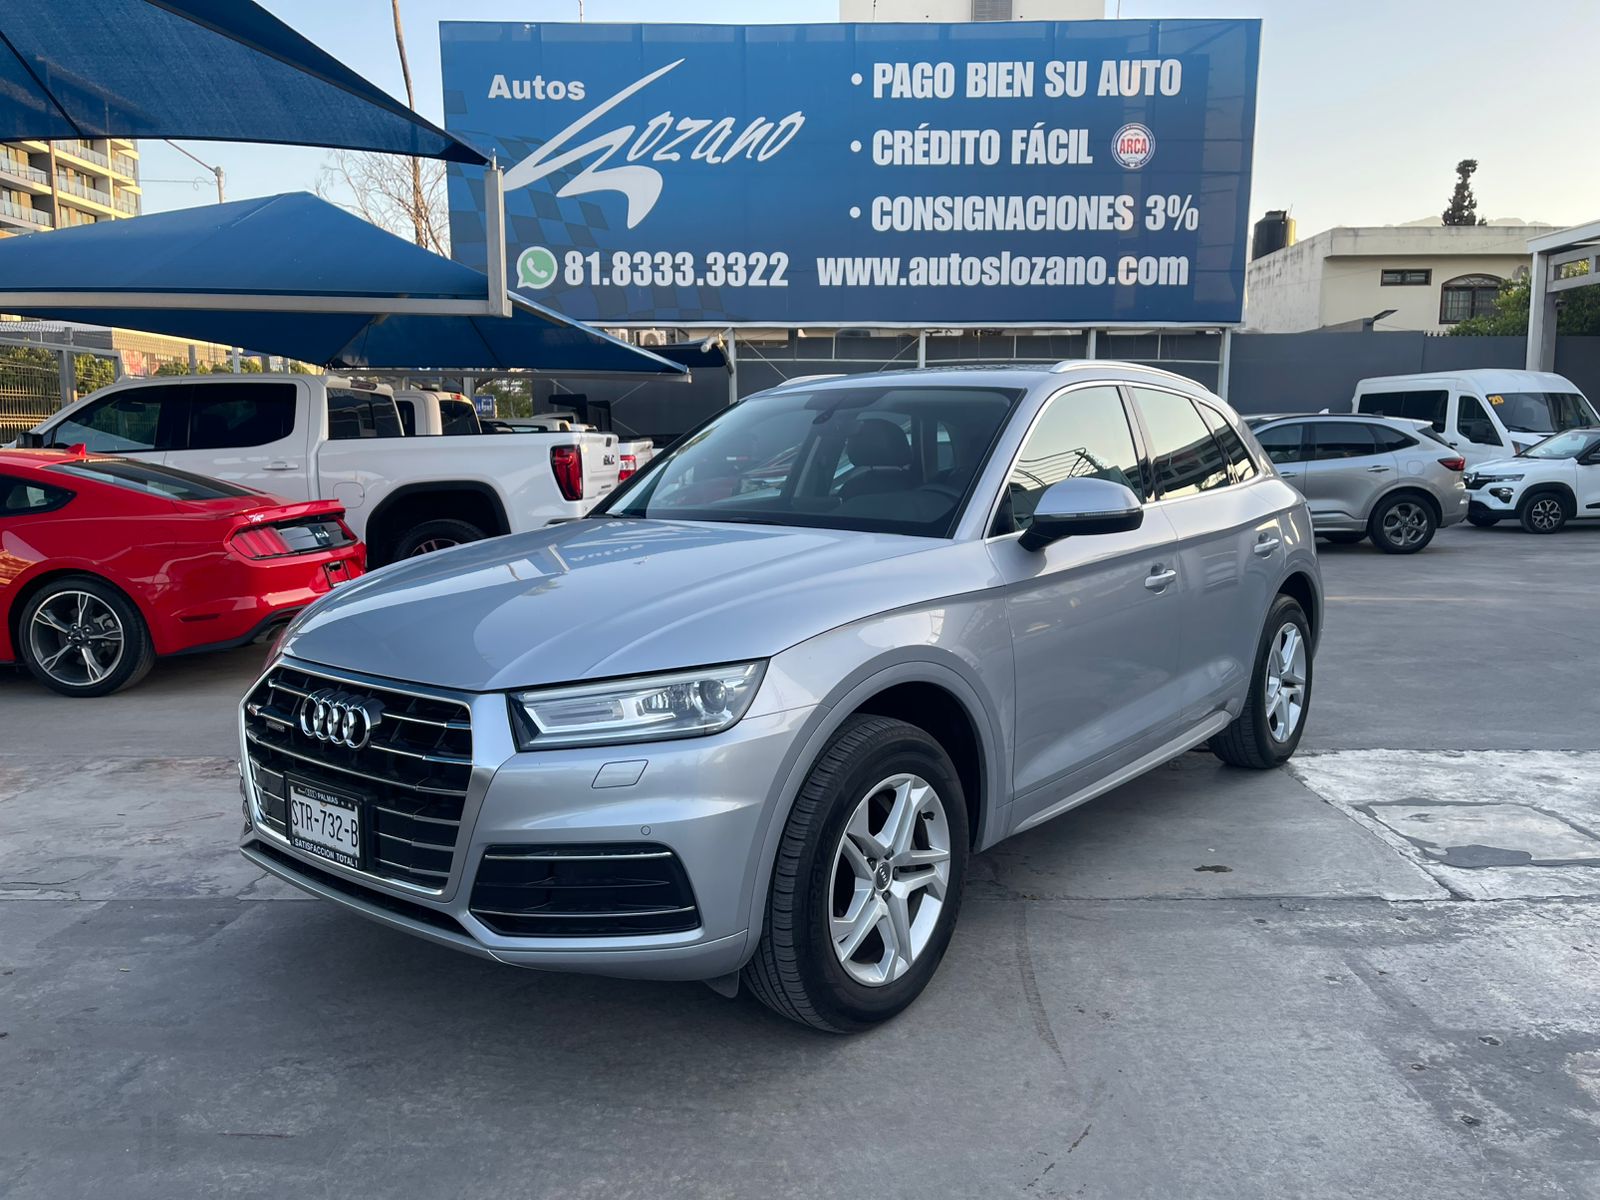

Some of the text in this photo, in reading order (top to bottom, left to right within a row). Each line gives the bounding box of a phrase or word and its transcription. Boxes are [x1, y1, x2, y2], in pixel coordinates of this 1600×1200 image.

[487, 74, 586, 101] Autos
[873, 59, 1182, 99] PAGO BIEN SU AUTO
[503, 58, 806, 230] Lozano
[872, 121, 1094, 166] CRÉDITO FÁCIL
[1119, 138, 1147, 154] ARCA
[871, 194, 1199, 232] CONSIGNACIONES 3%
[564, 250, 789, 287] 81.8333.3322
[816, 251, 1189, 287] www.autoslozano.com
[291, 799, 359, 849] STR-732-B
